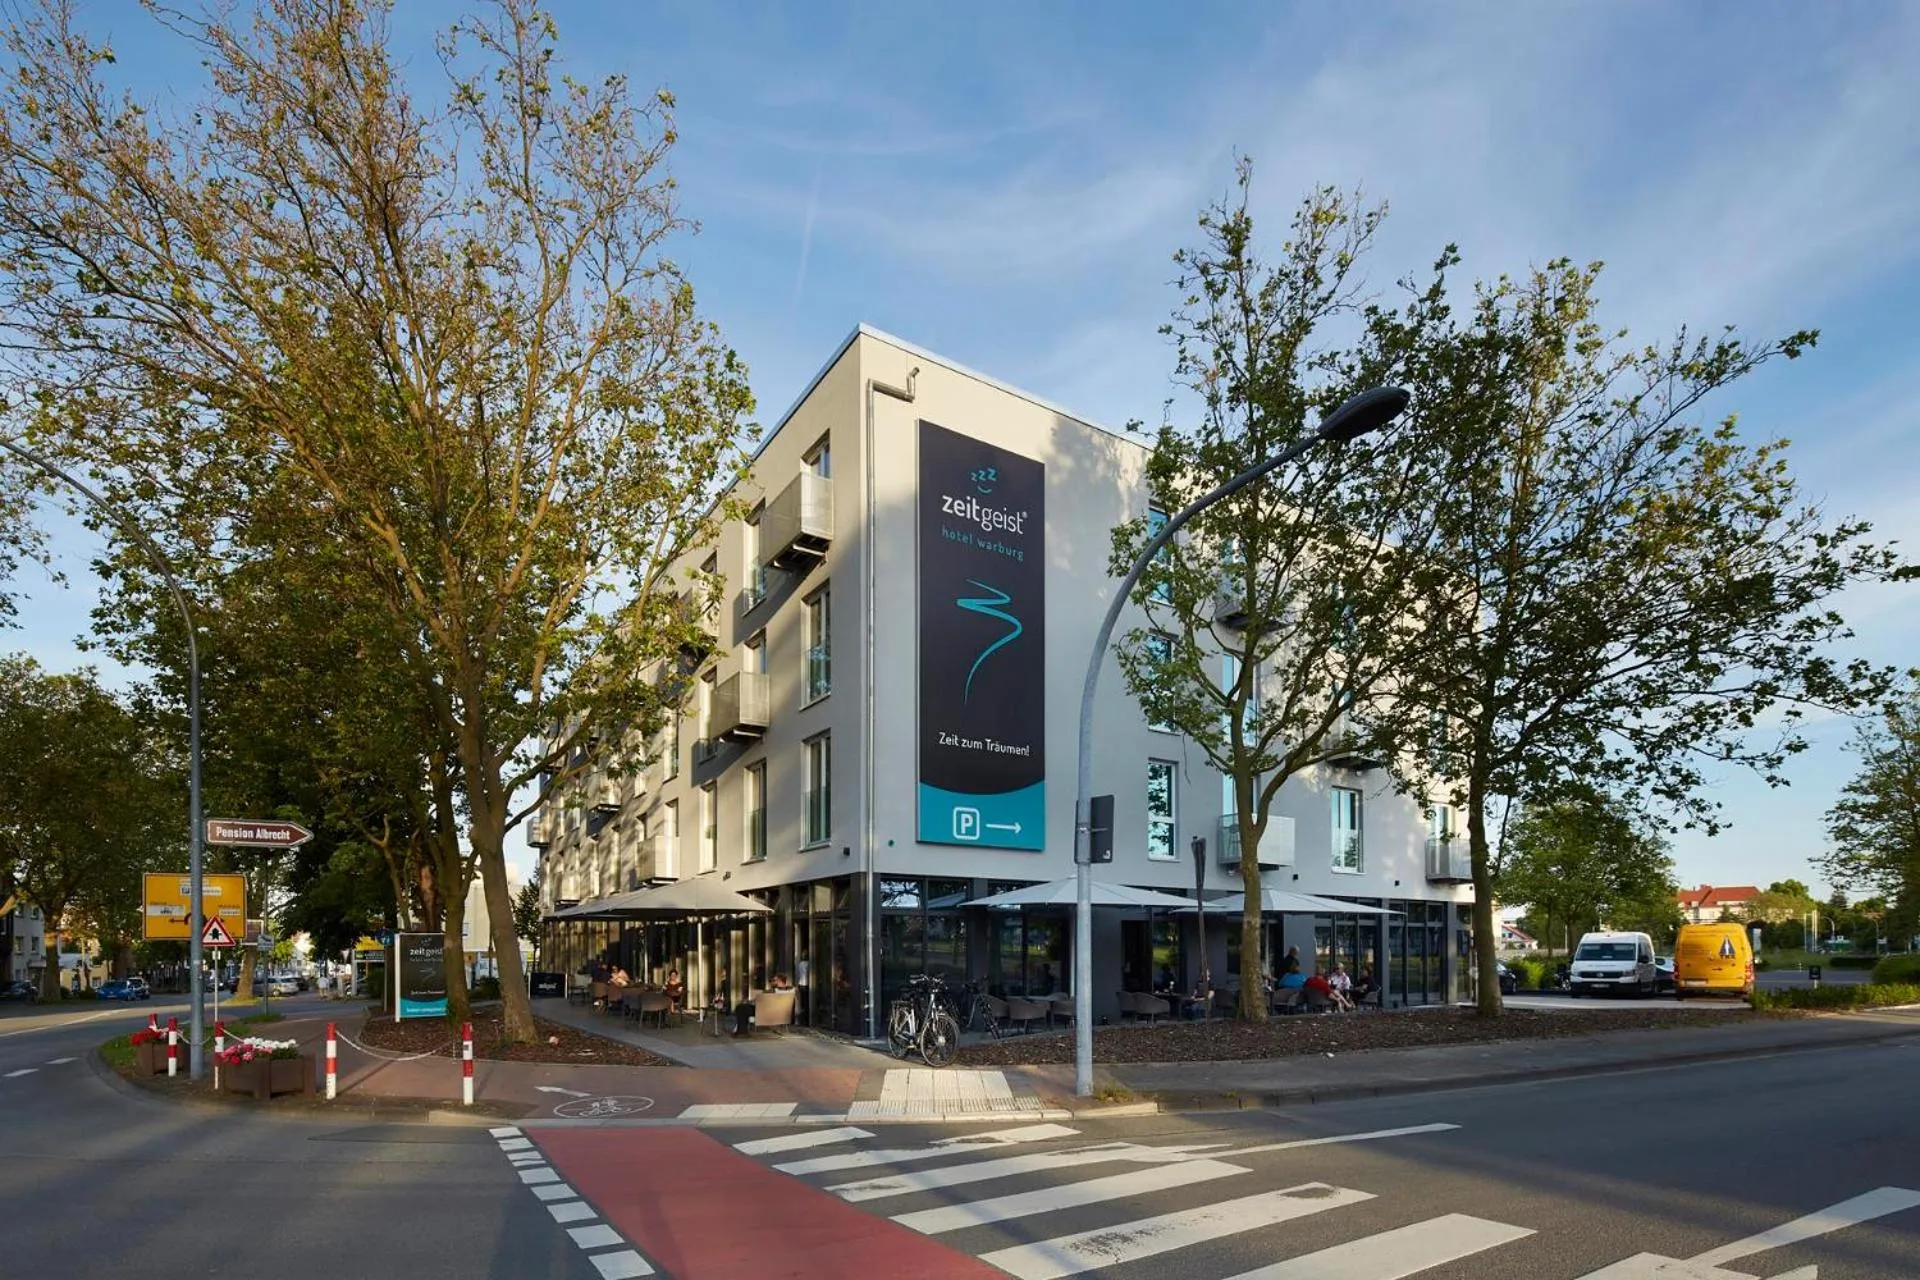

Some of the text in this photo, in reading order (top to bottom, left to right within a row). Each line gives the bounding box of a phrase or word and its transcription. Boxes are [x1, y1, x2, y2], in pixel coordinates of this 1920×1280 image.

[942, 525, 1024, 562] hotel warburg
[938, 731, 1030, 757] Zeit zum Träumen!
[216, 826, 291, 840] Pension Albrecht
[960, 813, 974, 834] P
